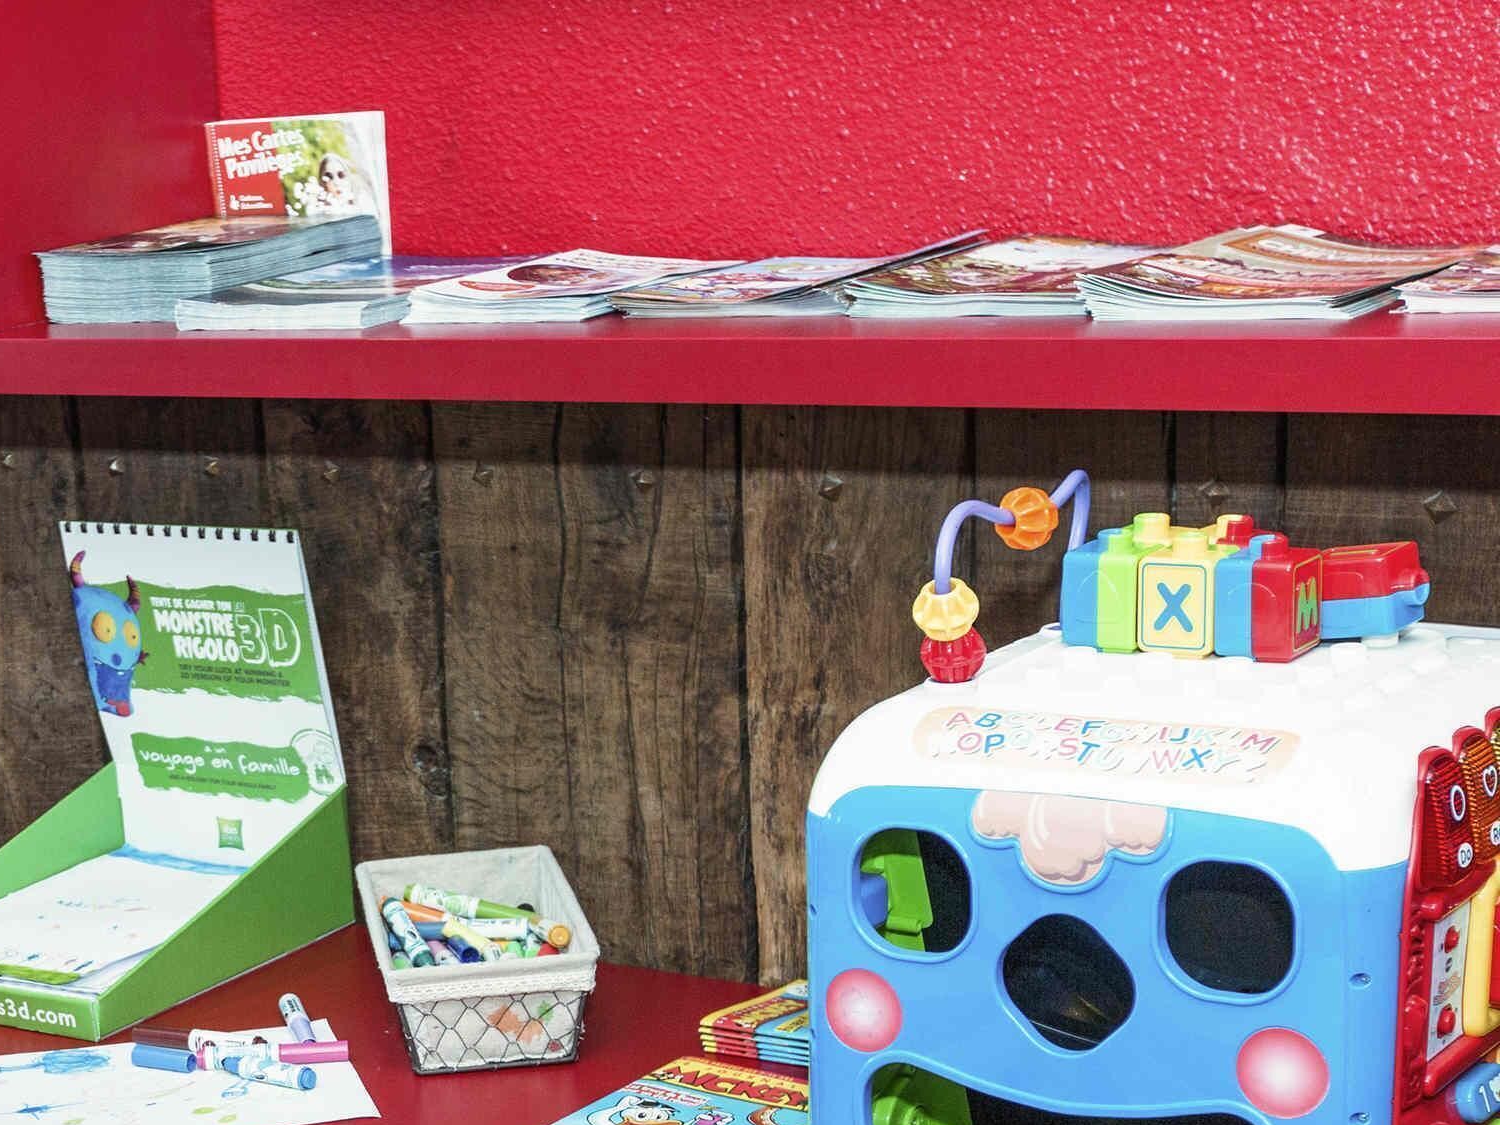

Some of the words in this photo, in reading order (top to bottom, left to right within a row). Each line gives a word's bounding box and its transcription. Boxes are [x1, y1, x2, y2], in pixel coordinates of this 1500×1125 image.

[217, 136, 252, 158] Mes
[251, 129, 304, 151] Cartes
[225, 151, 308, 179] Privilèges
[1153, 582, 1194, 633] X
[1297, 576, 1319, 634] M
[152, 609, 237, 638] MONSTRE
[172, 634, 241, 663] RIGOLO
[235, 608, 301, 668] 3D
[139, 749, 205, 774] voyage
[211, 756, 234, 770] en
[237, 754, 301, 777] famille
